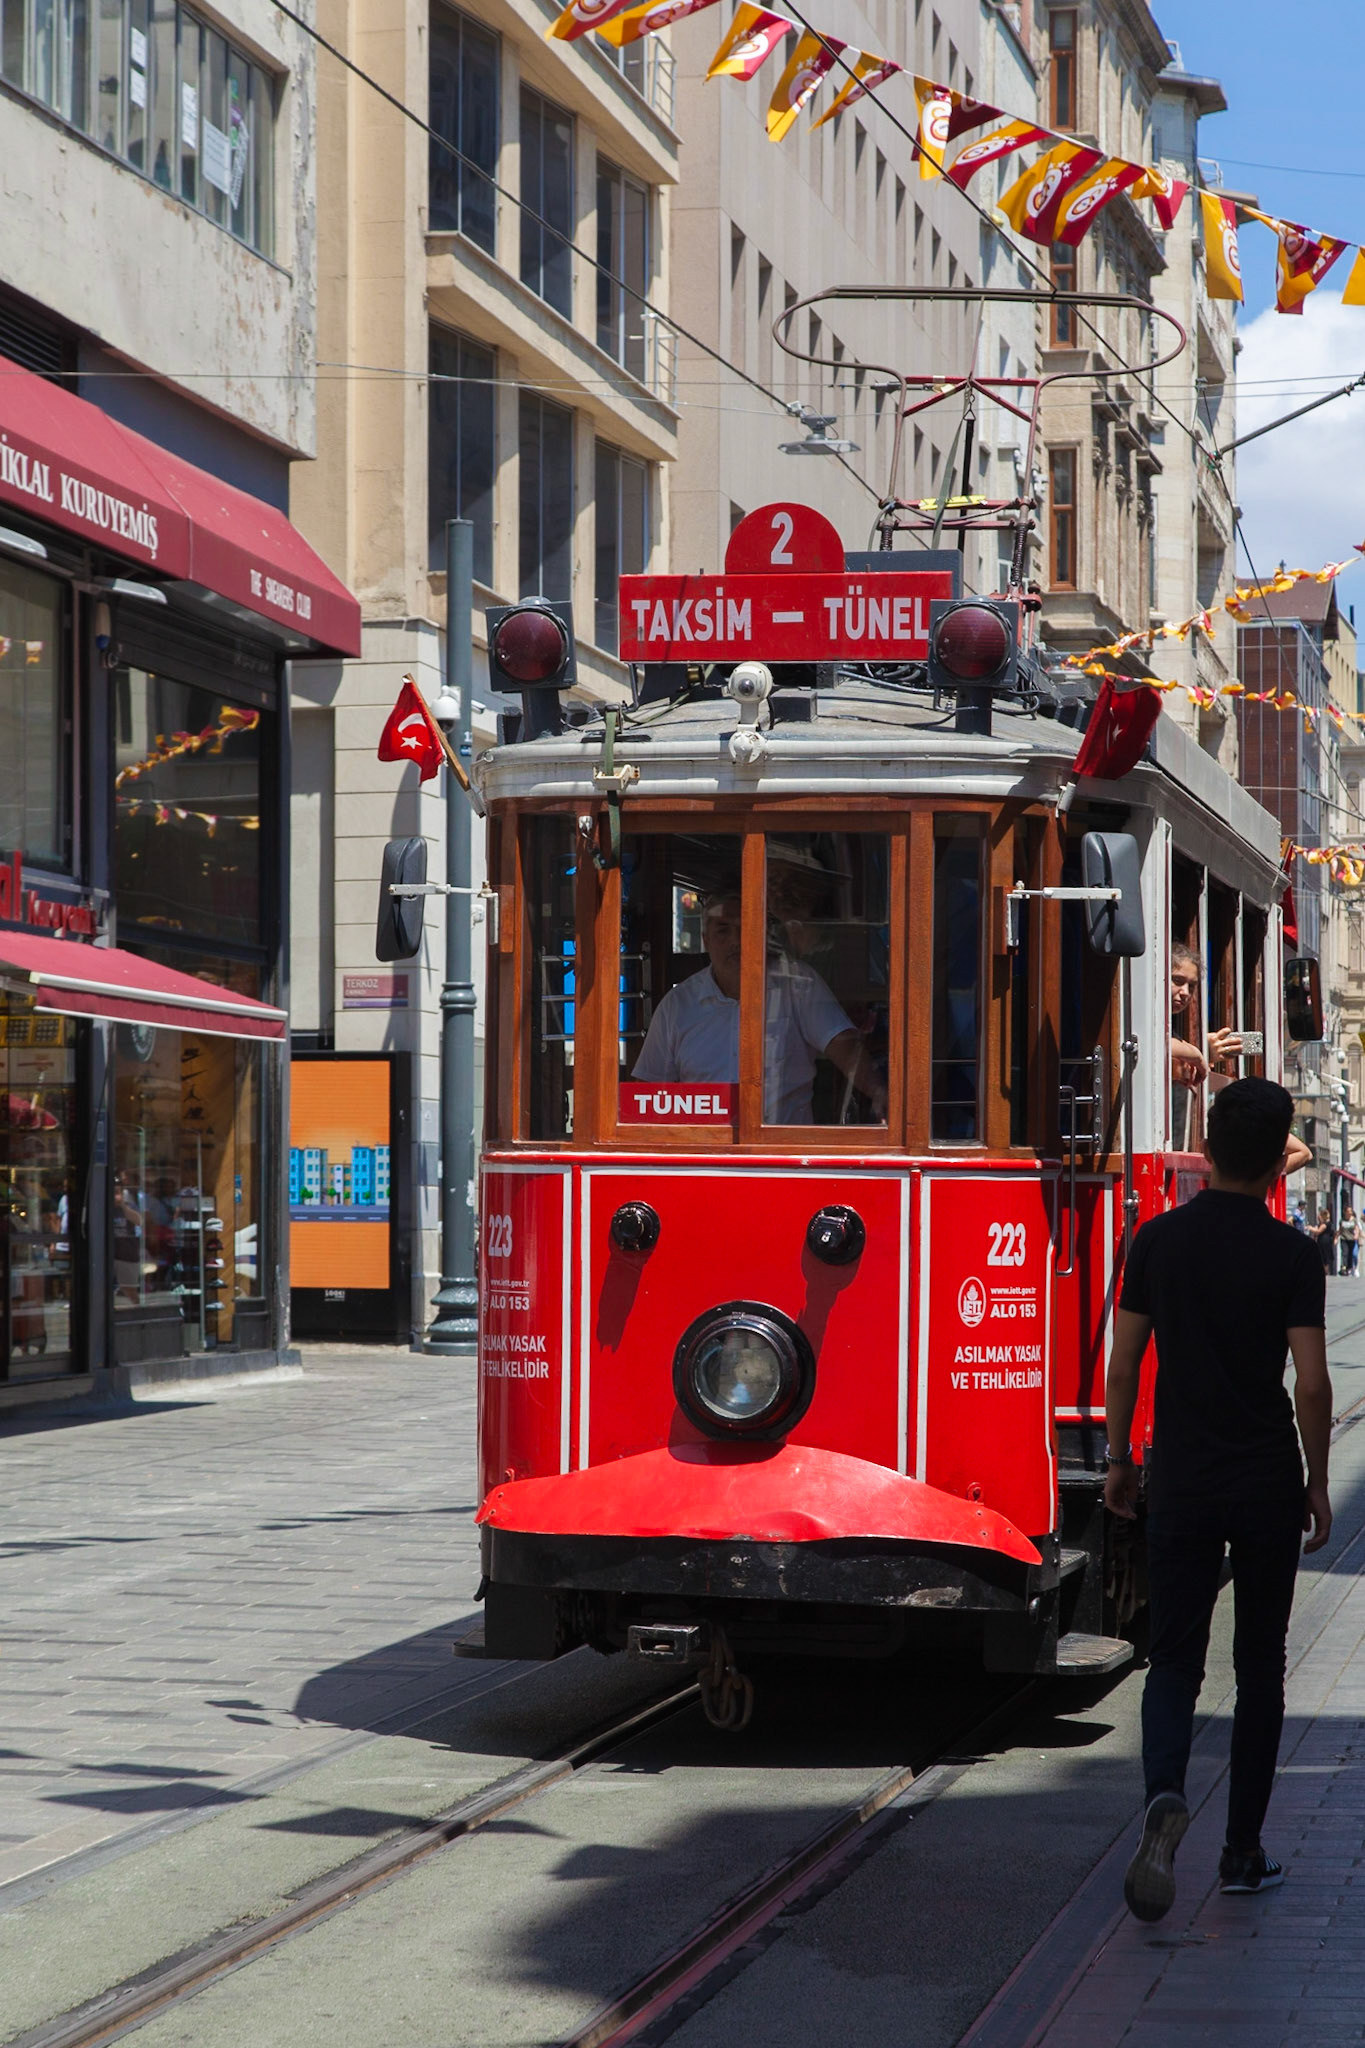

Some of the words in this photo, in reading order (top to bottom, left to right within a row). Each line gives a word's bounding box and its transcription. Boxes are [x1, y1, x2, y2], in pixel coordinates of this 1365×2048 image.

[0, 434, 54, 503] İKLAL
[60, 472, 159, 560] KURUYEMİŞ
[770, 511, 794, 565] 2
[631, 587, 752, 642] TAKSİM
[823, 585, 930, 640] TÜNEL
[634, 1090, 729, 1115] TÜNEL
[488, 1214, 513, 1258] 223
[987, 1222, 1026, 1267] 223
[508, 1296, 530, 1311] 153
[990, 1303, 1017, 1318] ALO
[1019, 1303, 1036, 1318] 153
[483, 1334, 508, 1352] SILMAK
[509, 1335, 547, 1352] YASAK
[954, 1345, 1013, 1364] ASILMAK
[1014, 1344, 1042, 1362] YASAK
[487, 1357, 549, 1379] TEHLİKELİDİR
[950, 1371, 969, 1390] VE
[972, 1366, 1043, 1390] TEHLİKELİDİR
